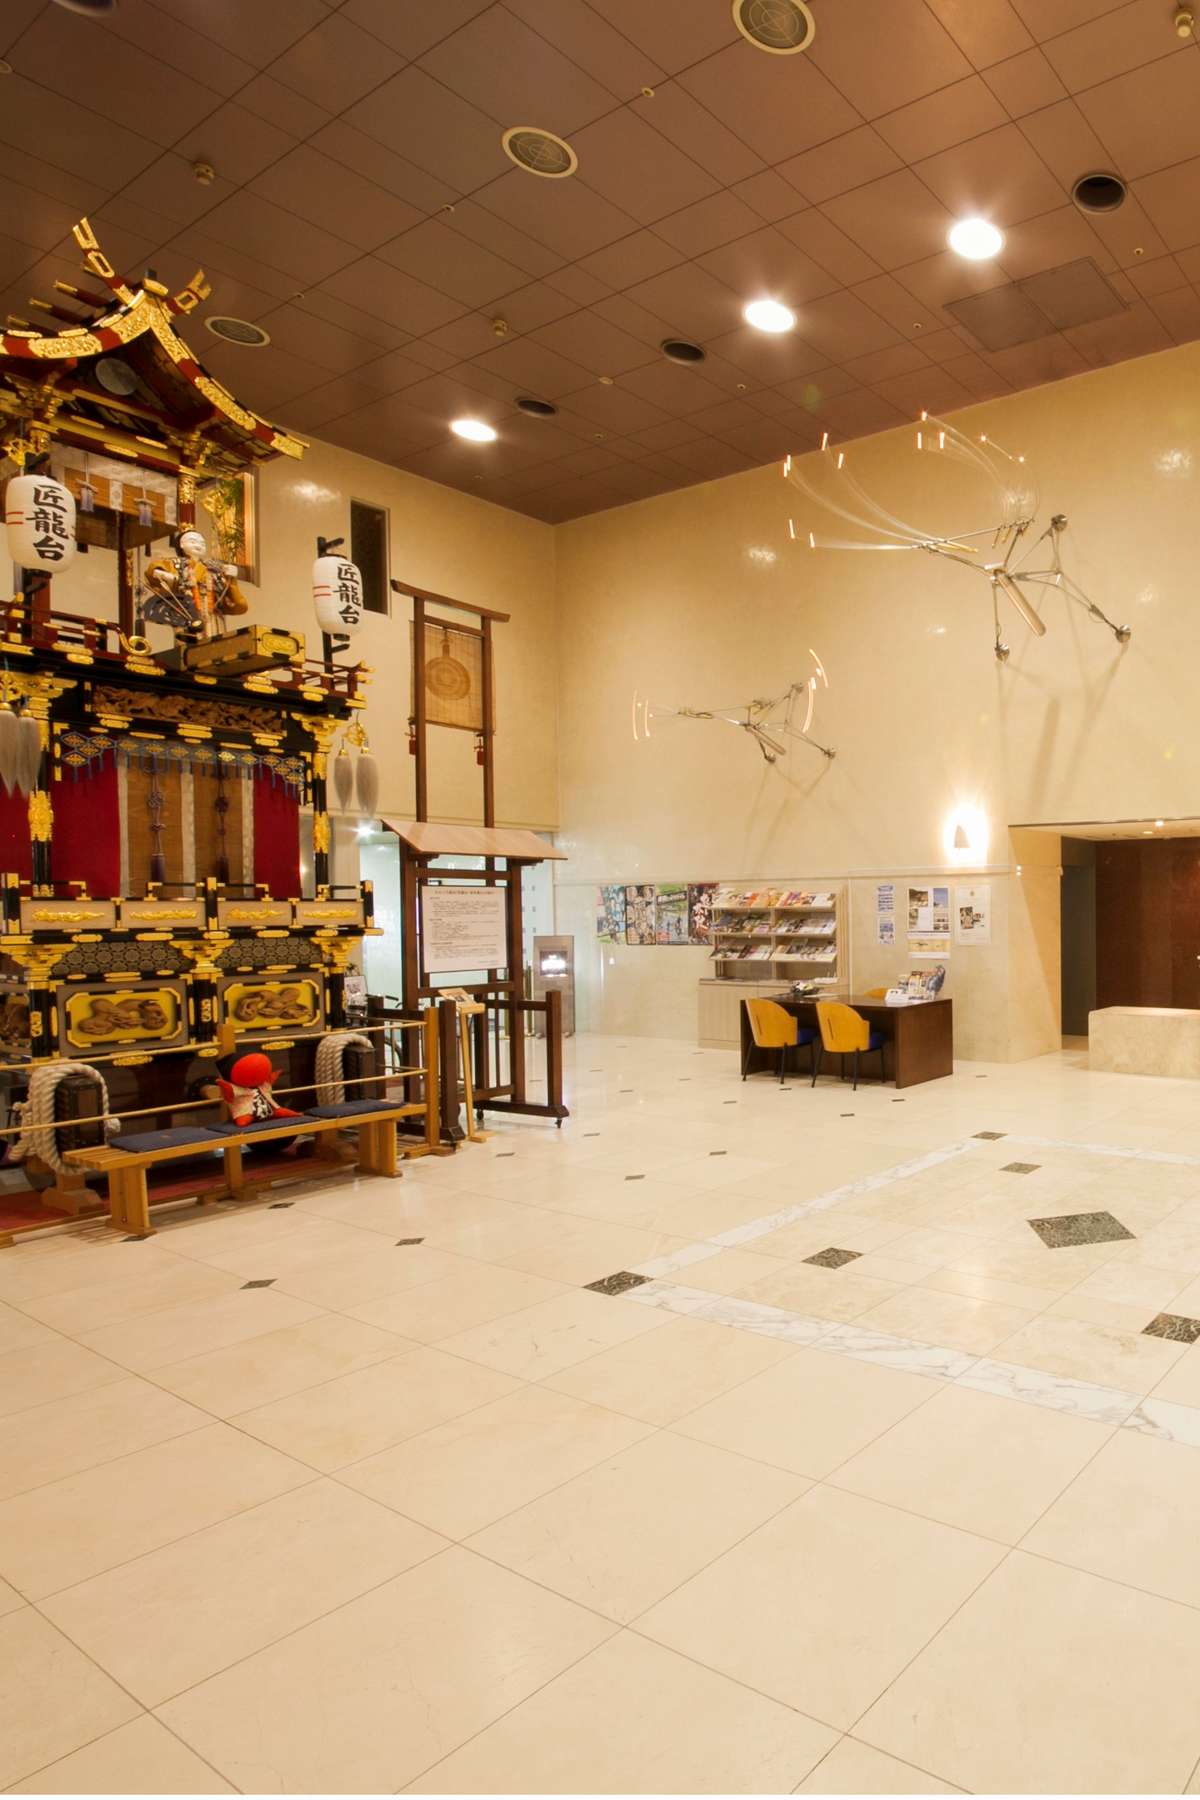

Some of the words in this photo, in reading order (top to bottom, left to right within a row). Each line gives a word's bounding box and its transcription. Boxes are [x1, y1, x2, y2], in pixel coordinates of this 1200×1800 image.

[25, 484, 69, 561] 匠龍台
[332, 563, 361, 625] 匠龍台
